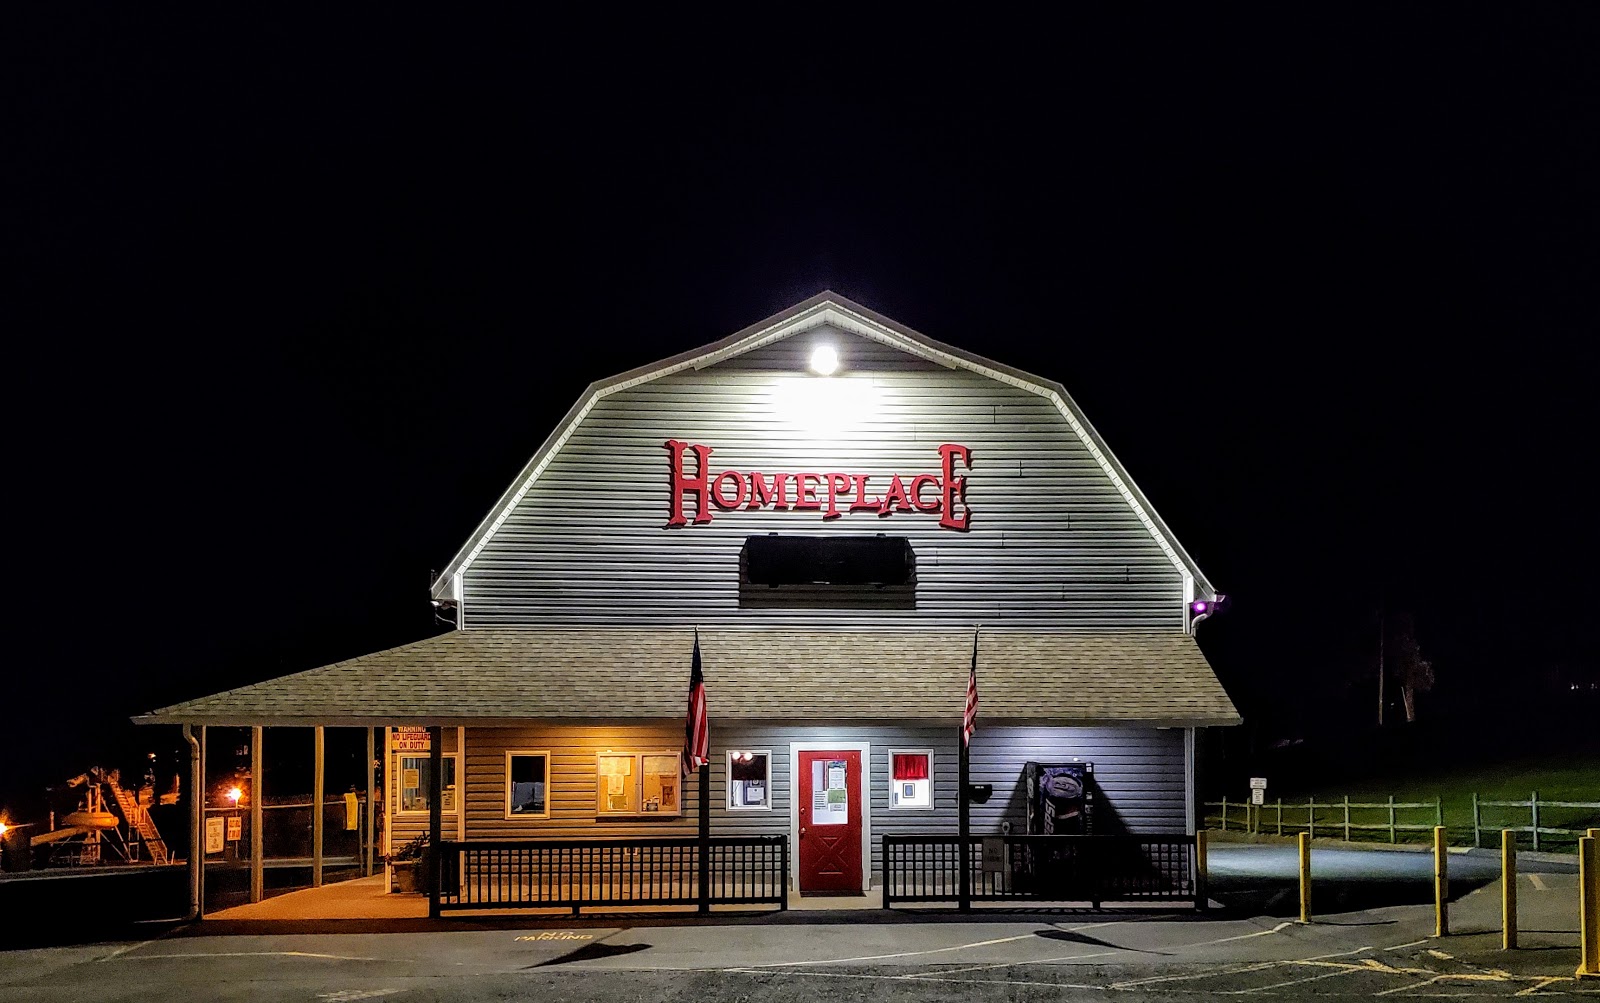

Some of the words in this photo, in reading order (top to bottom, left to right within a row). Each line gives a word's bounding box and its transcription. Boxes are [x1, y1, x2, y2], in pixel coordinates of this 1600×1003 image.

[664, 439, 971, 531] HOMEPLACE
[392, 733, 400, 741] NO
[402, 733, 431, 741] LIFEGUARD
[399, 741, 407, 749] ON
[409, 741, 425, 749] DUTY
[514, 934, 594, 942] PARKING
